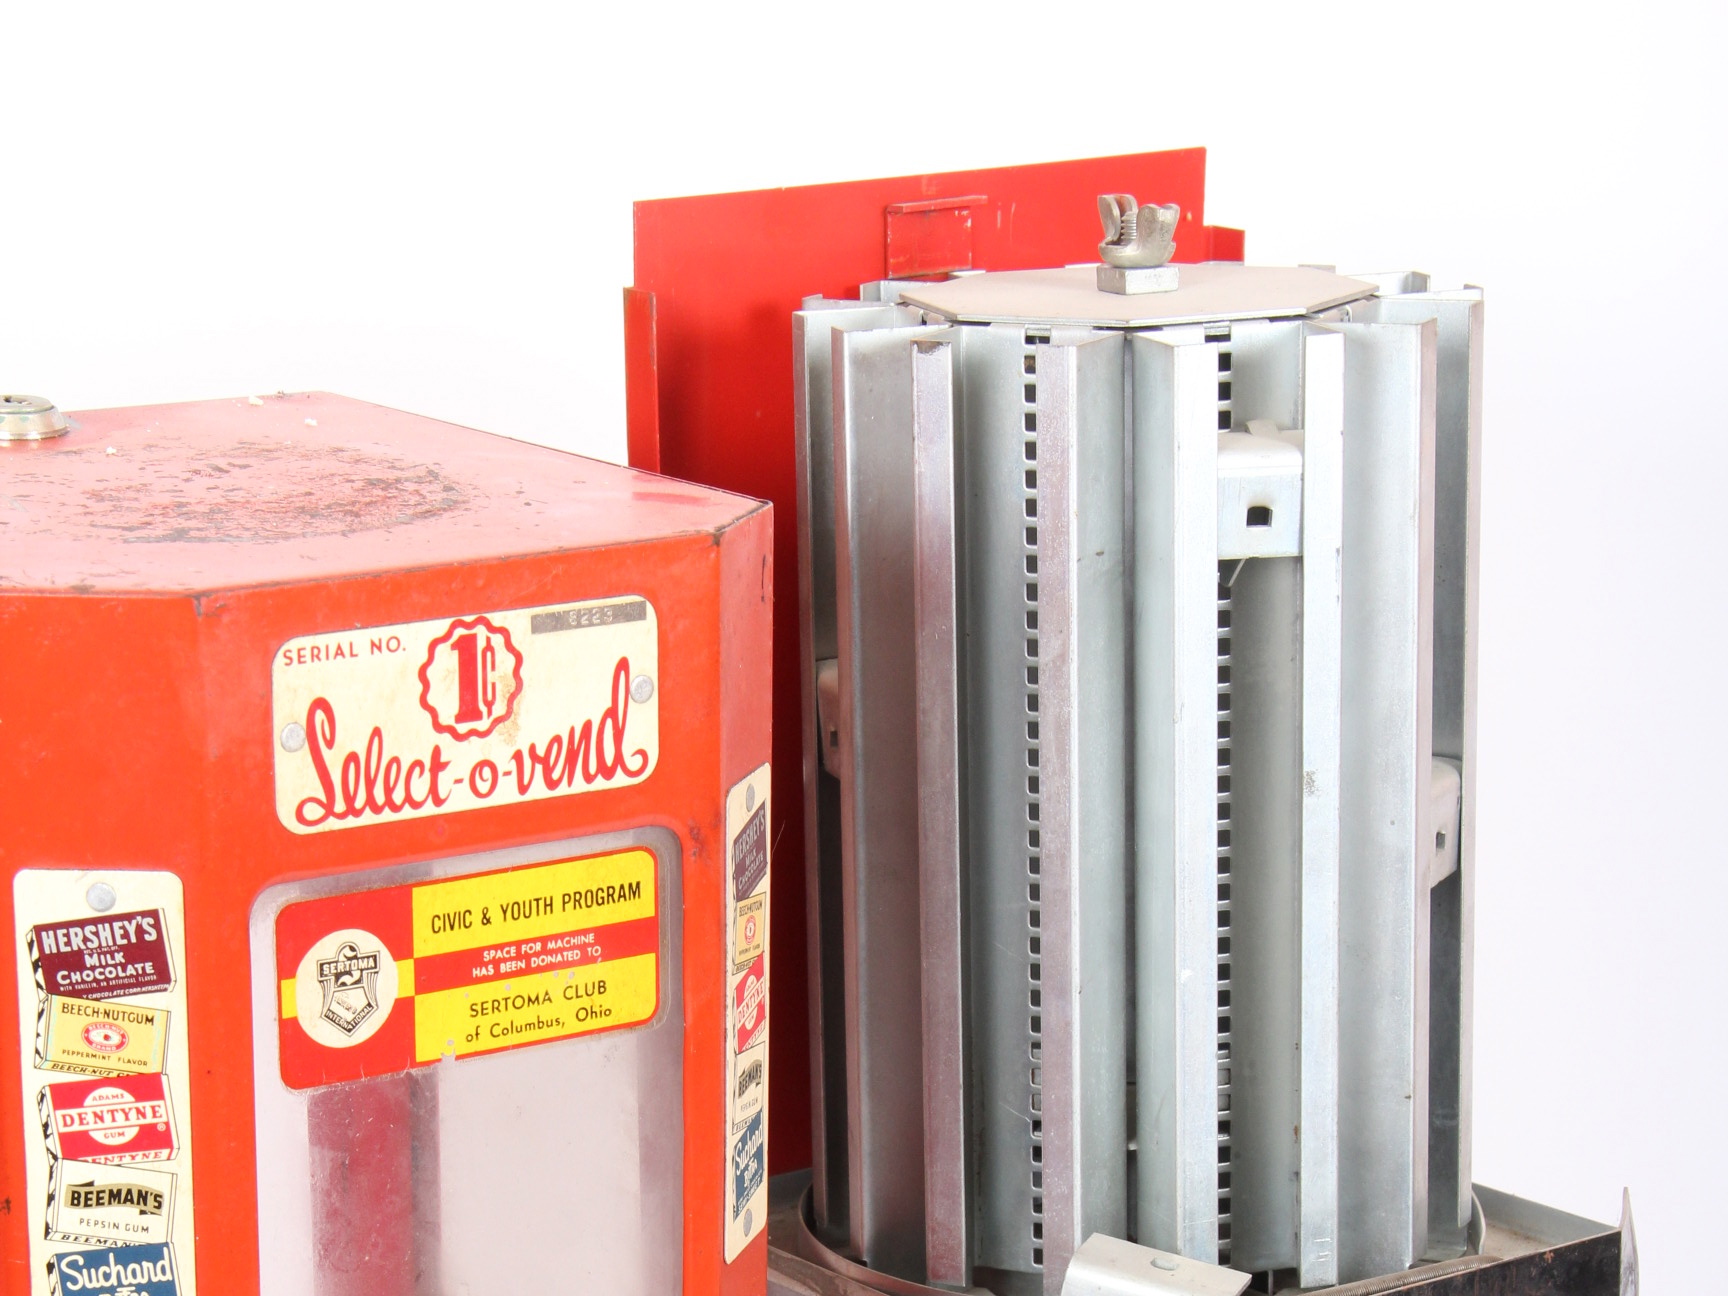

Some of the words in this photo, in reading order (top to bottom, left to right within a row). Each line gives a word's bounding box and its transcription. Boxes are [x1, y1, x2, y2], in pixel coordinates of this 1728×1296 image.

[283, 641, 359, 667] SERIAL
[370, 635, 406, 656] NO.
[295, 656, 649, 826] Select-o-vend
[735, 809, 765, 864] HERSHEY'S
[431, 907, 473, 934] CIVIC
[481, 906, 492, 926] &
[500, 896, 554, 922] YOUTH
[562, 880, 642, 913] PROGRAM
[41, 916, 157, 954] HERSHEY'S
[483, 945, 517, 962] SPACE
[521, 941, 541, 956] FOR
[547, 933, 596, 952] MACHINE
[84, 951, 126, 968] MILK
[323, 956, 375, 974] SERTOMA
[472, 963, 495, 978] HAS
[499, 957, 526, 974] BEEN
[531, 949, 581, 968] DONATED
[587, 945, 601, 958] TO
[56, 962, 155, 985] CHOCOLATE
[87, 989, 124, 999] CHOCOLATE
[469, 989, 554, 1018] SERTOMA
[563, 980, 607, 1001] CLUB
[326, 1005, 373, 1031] INTERNATIONAL
[465, 1024, 481, 1044] of
[489, 1014, 565, 1039] Columbus,
[575, 1005, 612, 1023] Ohio
[62, 1049, 111, 1061] PEPPERMINT
[118, 1057, 148, 1066] FLAVOR
[92, 1043, 117, 1051] BRAND
[51, 1063, 114, 1076] BEECH-NUT
[92, 1093, 125, 1102] ADAMS
[61, 1104, 163, 1129] DENTYNE
[103, 1131, 126, 1140] GUM
[735, 1112, 763, 1176] Suchard
[70, 1188, 163, 1210] BEEMAN'S
[80, 1218, 120, 1230] PEPSIN
[125, 1223, 150, 1234] GUM
[60, 1246, 173, 1290] Suchard
